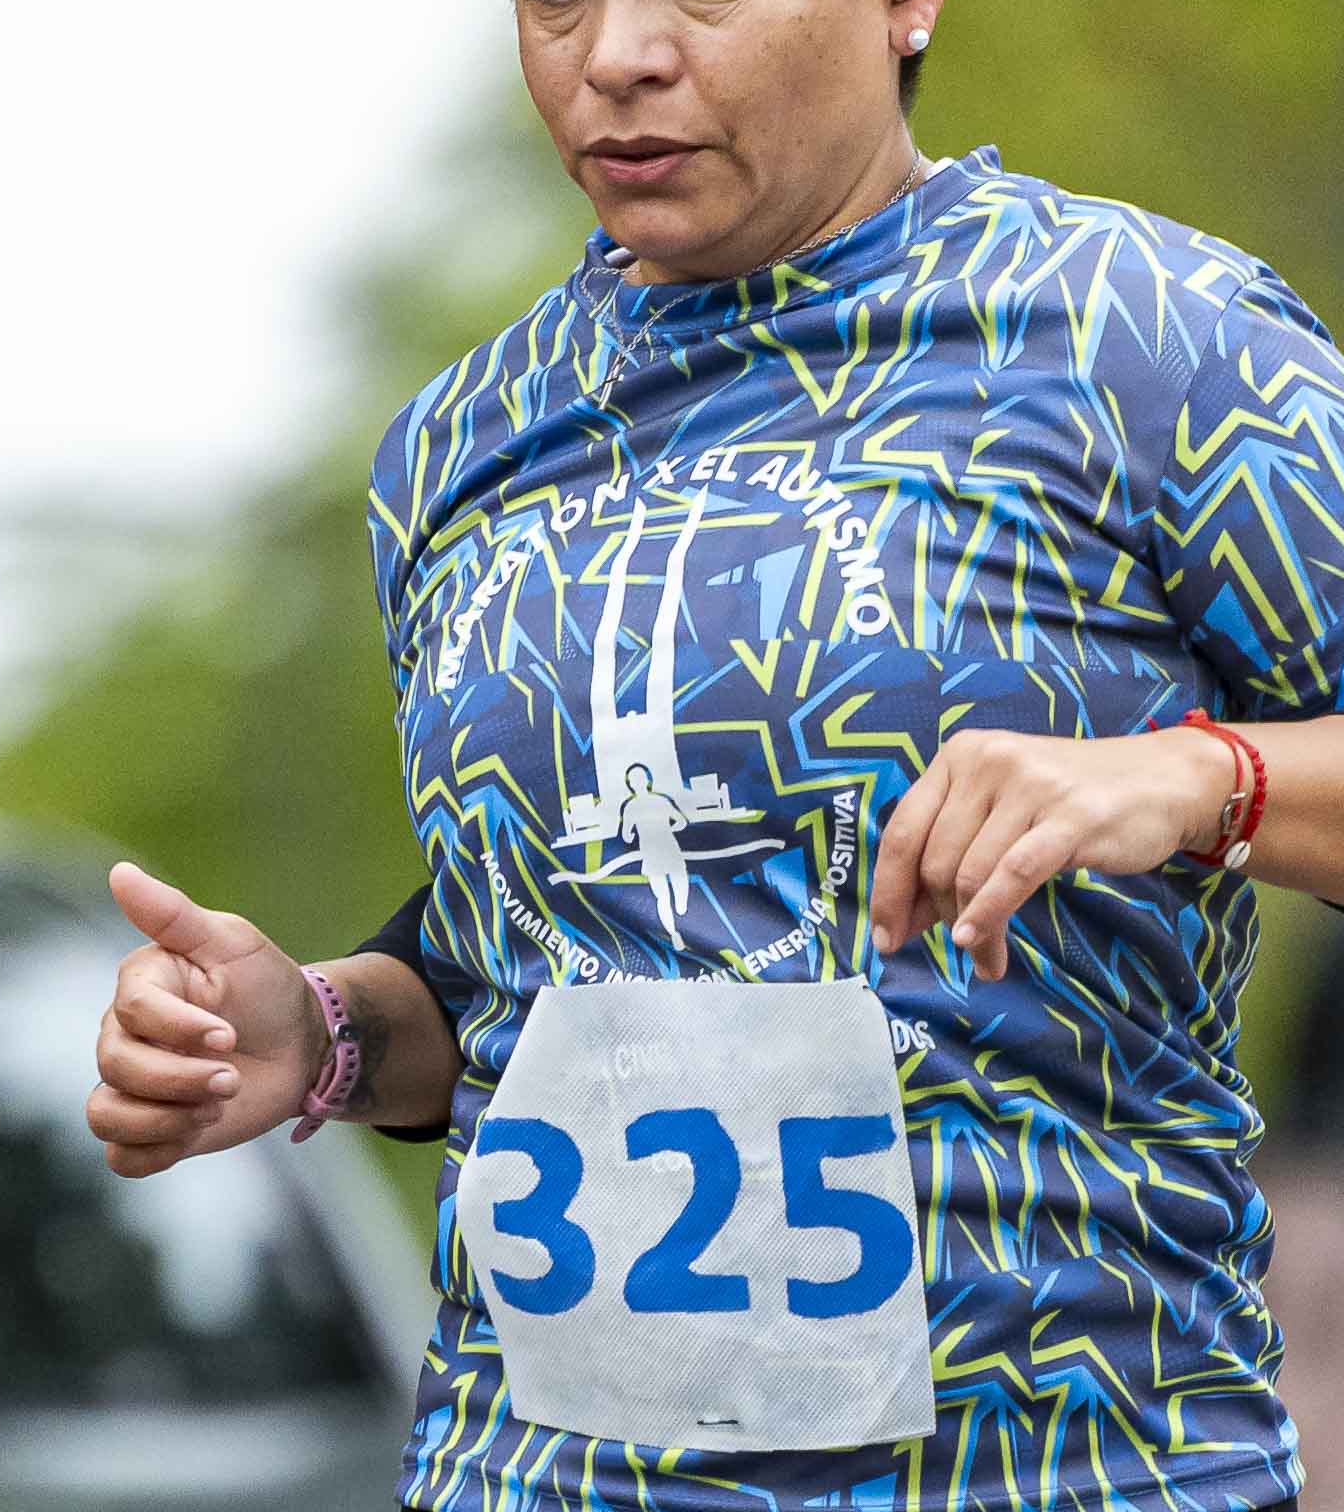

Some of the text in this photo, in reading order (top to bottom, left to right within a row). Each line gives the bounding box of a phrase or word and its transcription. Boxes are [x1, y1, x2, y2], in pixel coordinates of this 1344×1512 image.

[435, 473, 631, 689] MARATÓN
[690, 444, 739, 482] EL
[745, 454, 890, 636] AUTISMO
[480, 850, 600, 984] MOVIMIENTO,
[819, 790, 857, 898] POSITIVA
[475, 1107, 915, 1320] 325
